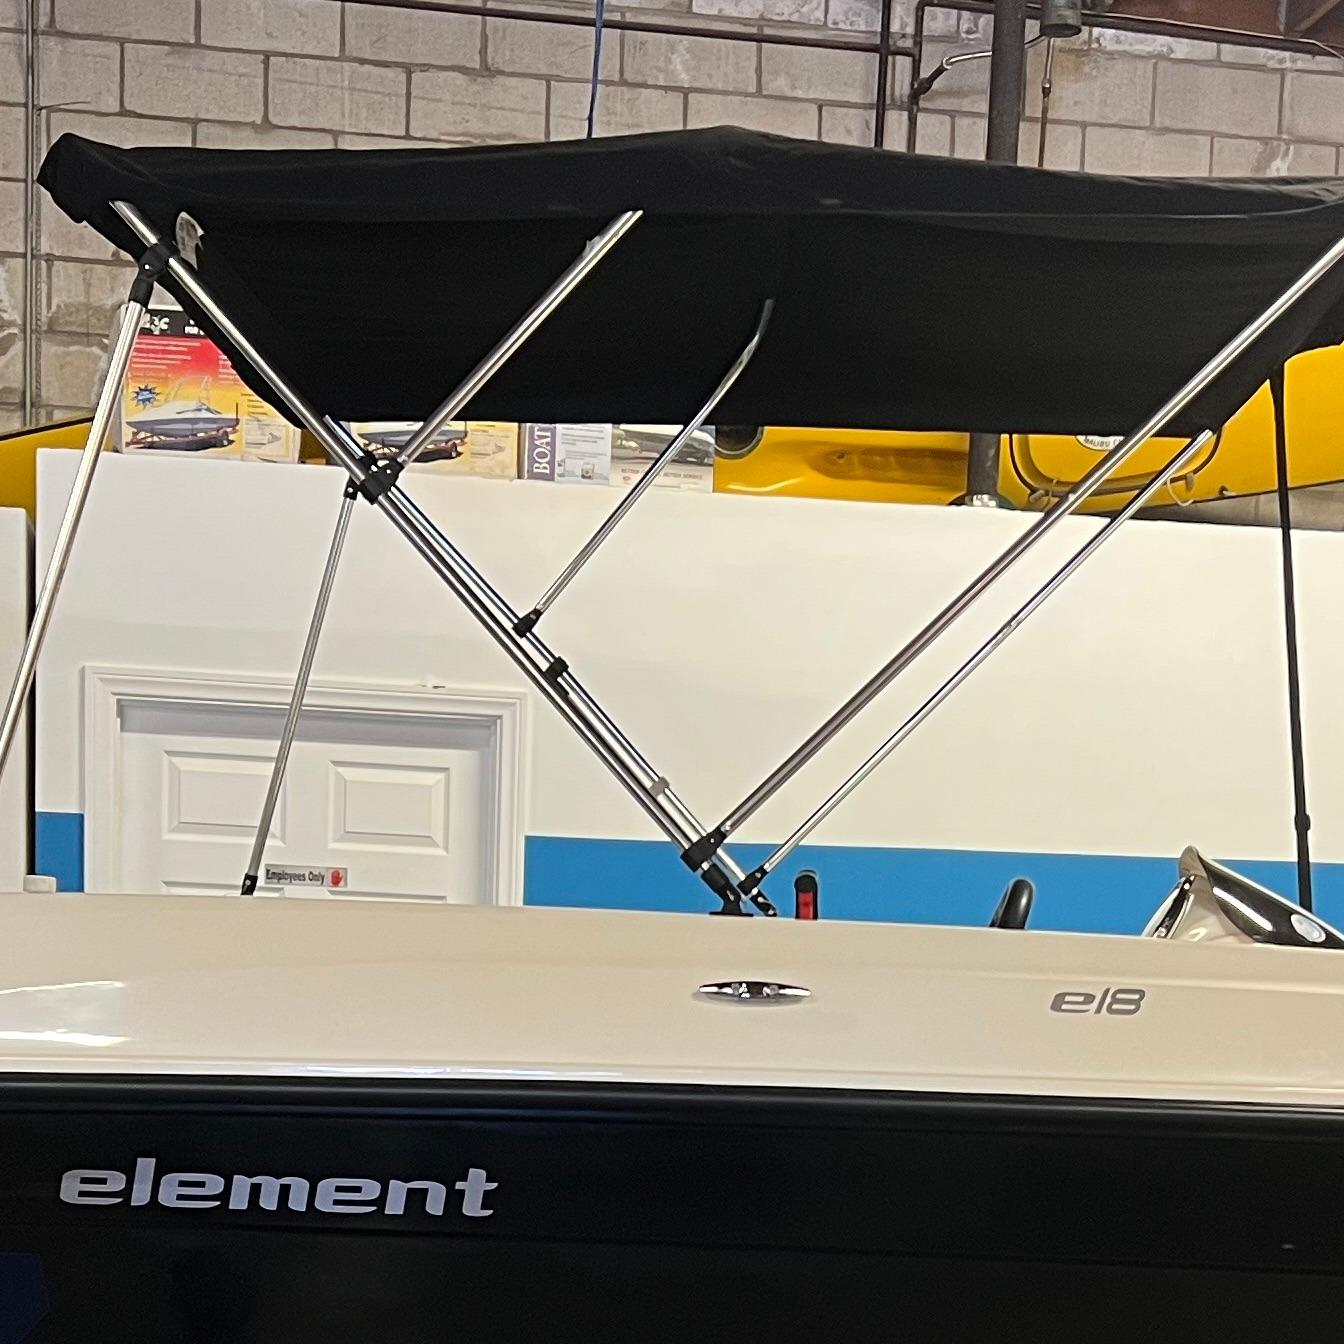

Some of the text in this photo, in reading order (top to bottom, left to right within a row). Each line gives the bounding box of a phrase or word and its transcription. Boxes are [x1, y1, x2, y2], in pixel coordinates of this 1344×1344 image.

[533, 426, 551, 474] BOAT
[265, 868, 325, 886] Employees Only
[59, 1157, 499, 1217] element
